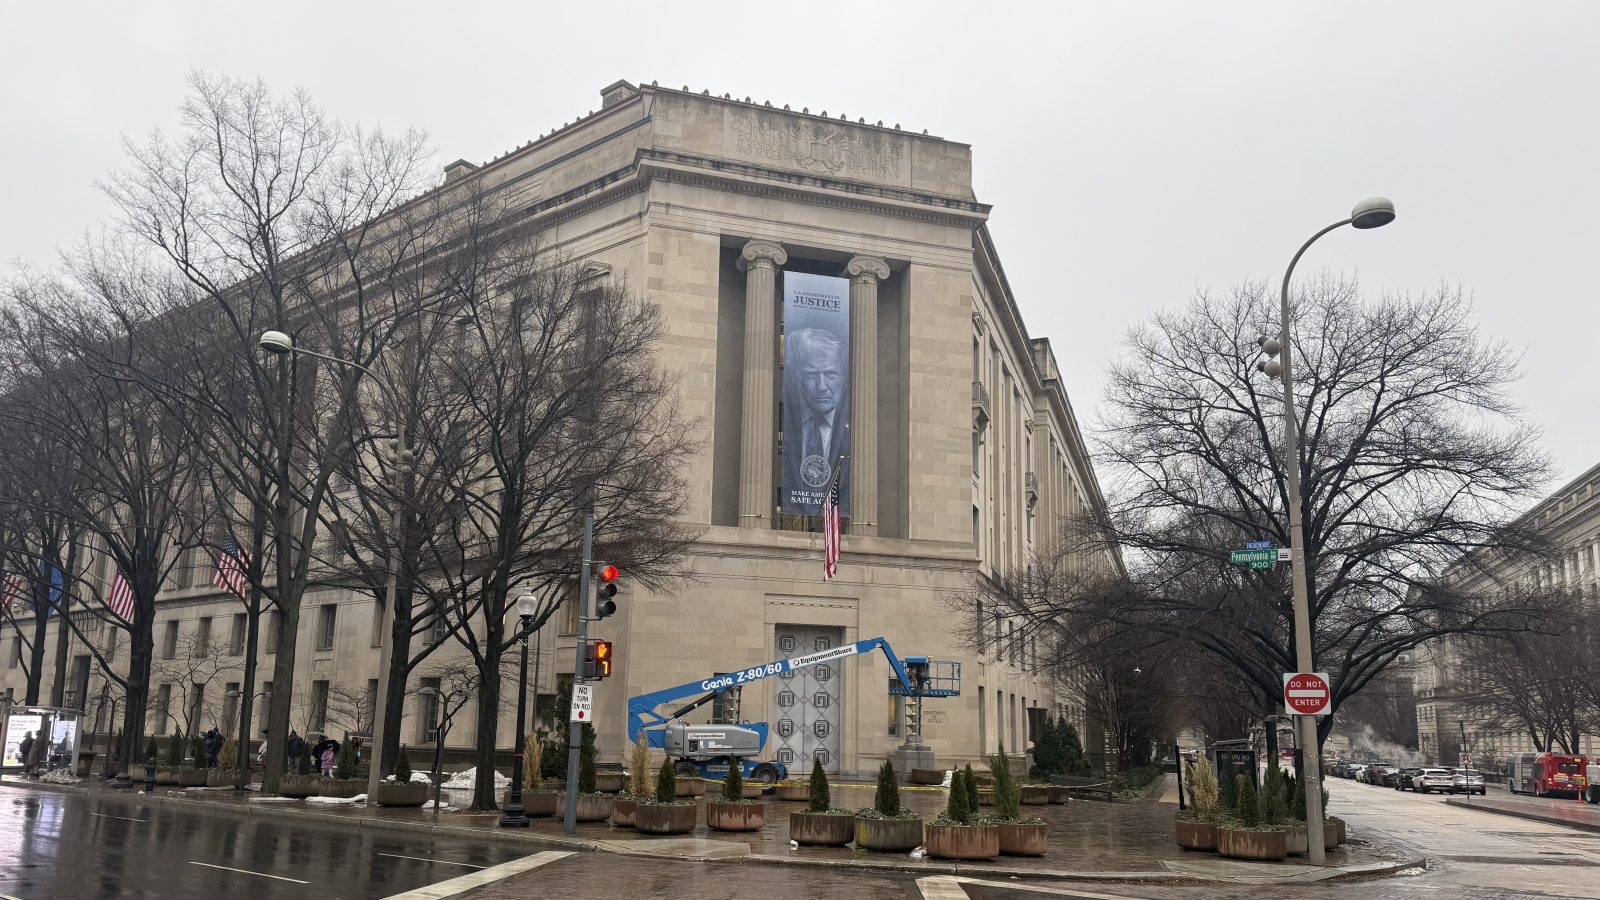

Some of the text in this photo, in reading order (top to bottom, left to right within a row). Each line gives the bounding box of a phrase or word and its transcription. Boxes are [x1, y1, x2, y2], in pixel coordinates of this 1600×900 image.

[794, 296, 841, 309] JUSTICE
[791, 496, 811, 504] SAFE
[1231, 550, 1269, 562] Pennsylvania
[1251, 561, 1269, 569] 900
[800, 648, 852, 663] EquipmentShare
[702, 662, 782, 690] Genie Z-80/60
